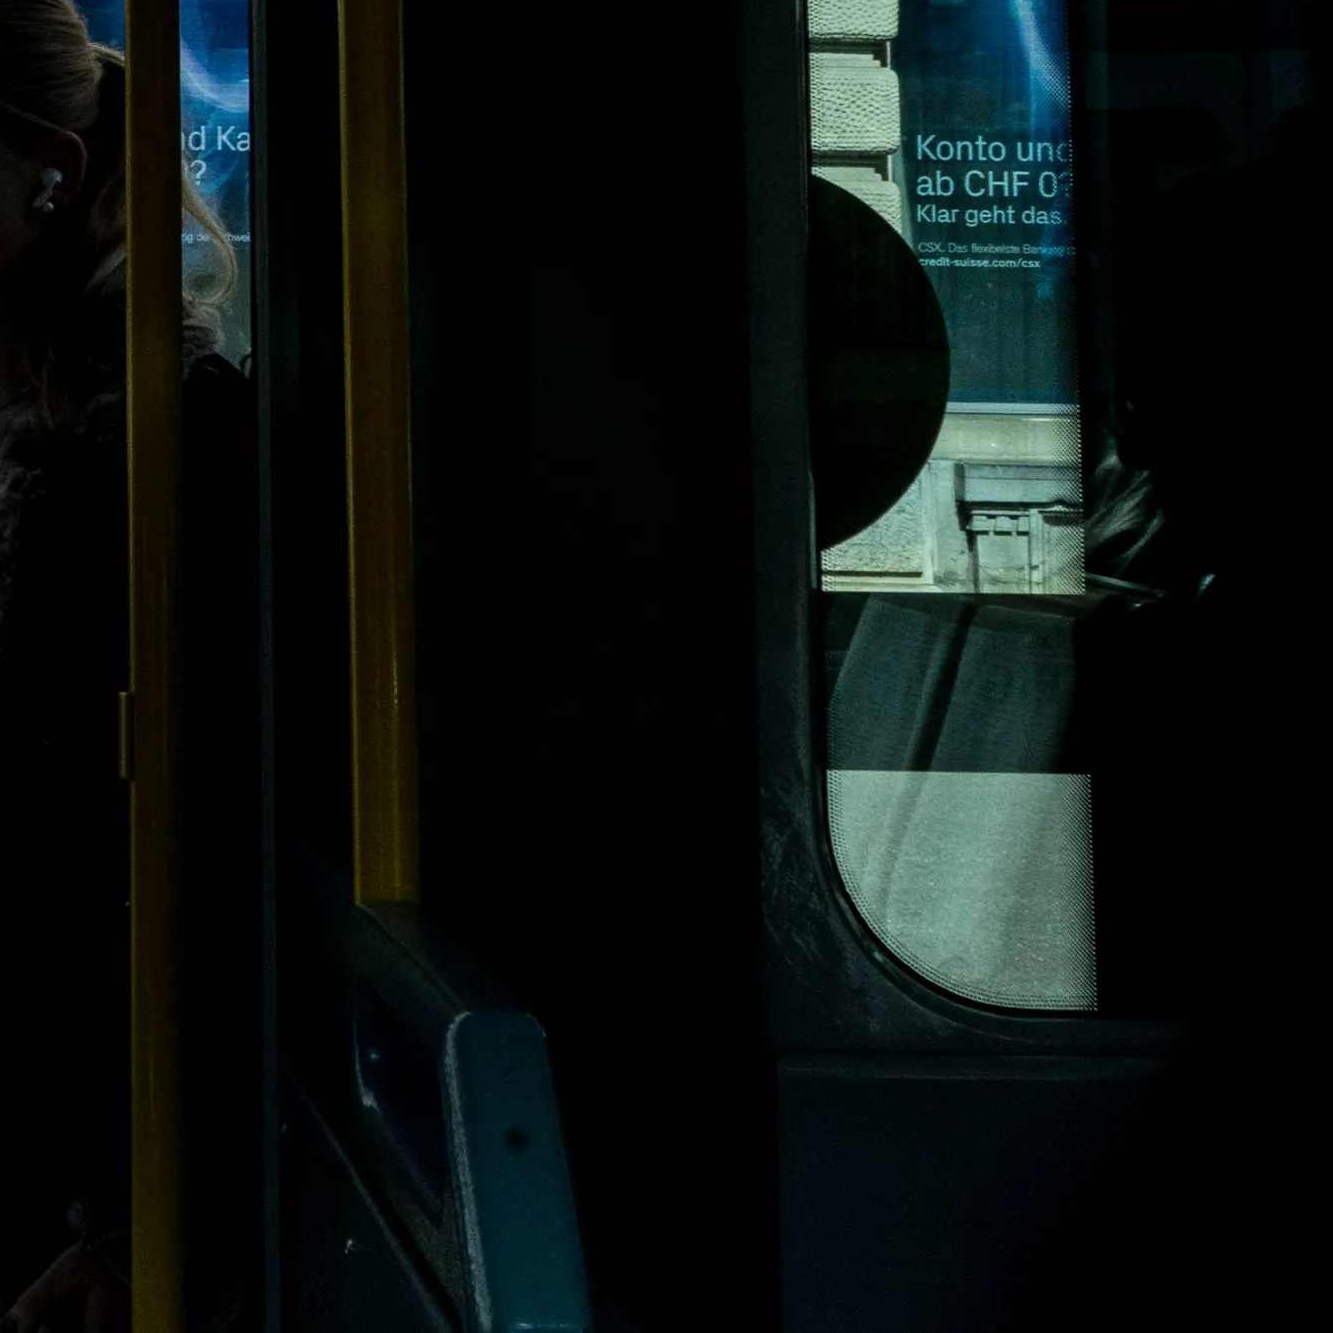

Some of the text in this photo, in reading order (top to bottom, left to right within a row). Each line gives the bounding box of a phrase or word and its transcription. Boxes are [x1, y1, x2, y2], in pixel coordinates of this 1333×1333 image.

[916, 134, 1007, 162] Konto
[916, 169, 954, 197] ab
[964, 169, 1030, 198] CHF
[916, 204, 960, 224] Klar
[965, 205, 1016, 228] geht
[948, 242, 968, 253] Das
